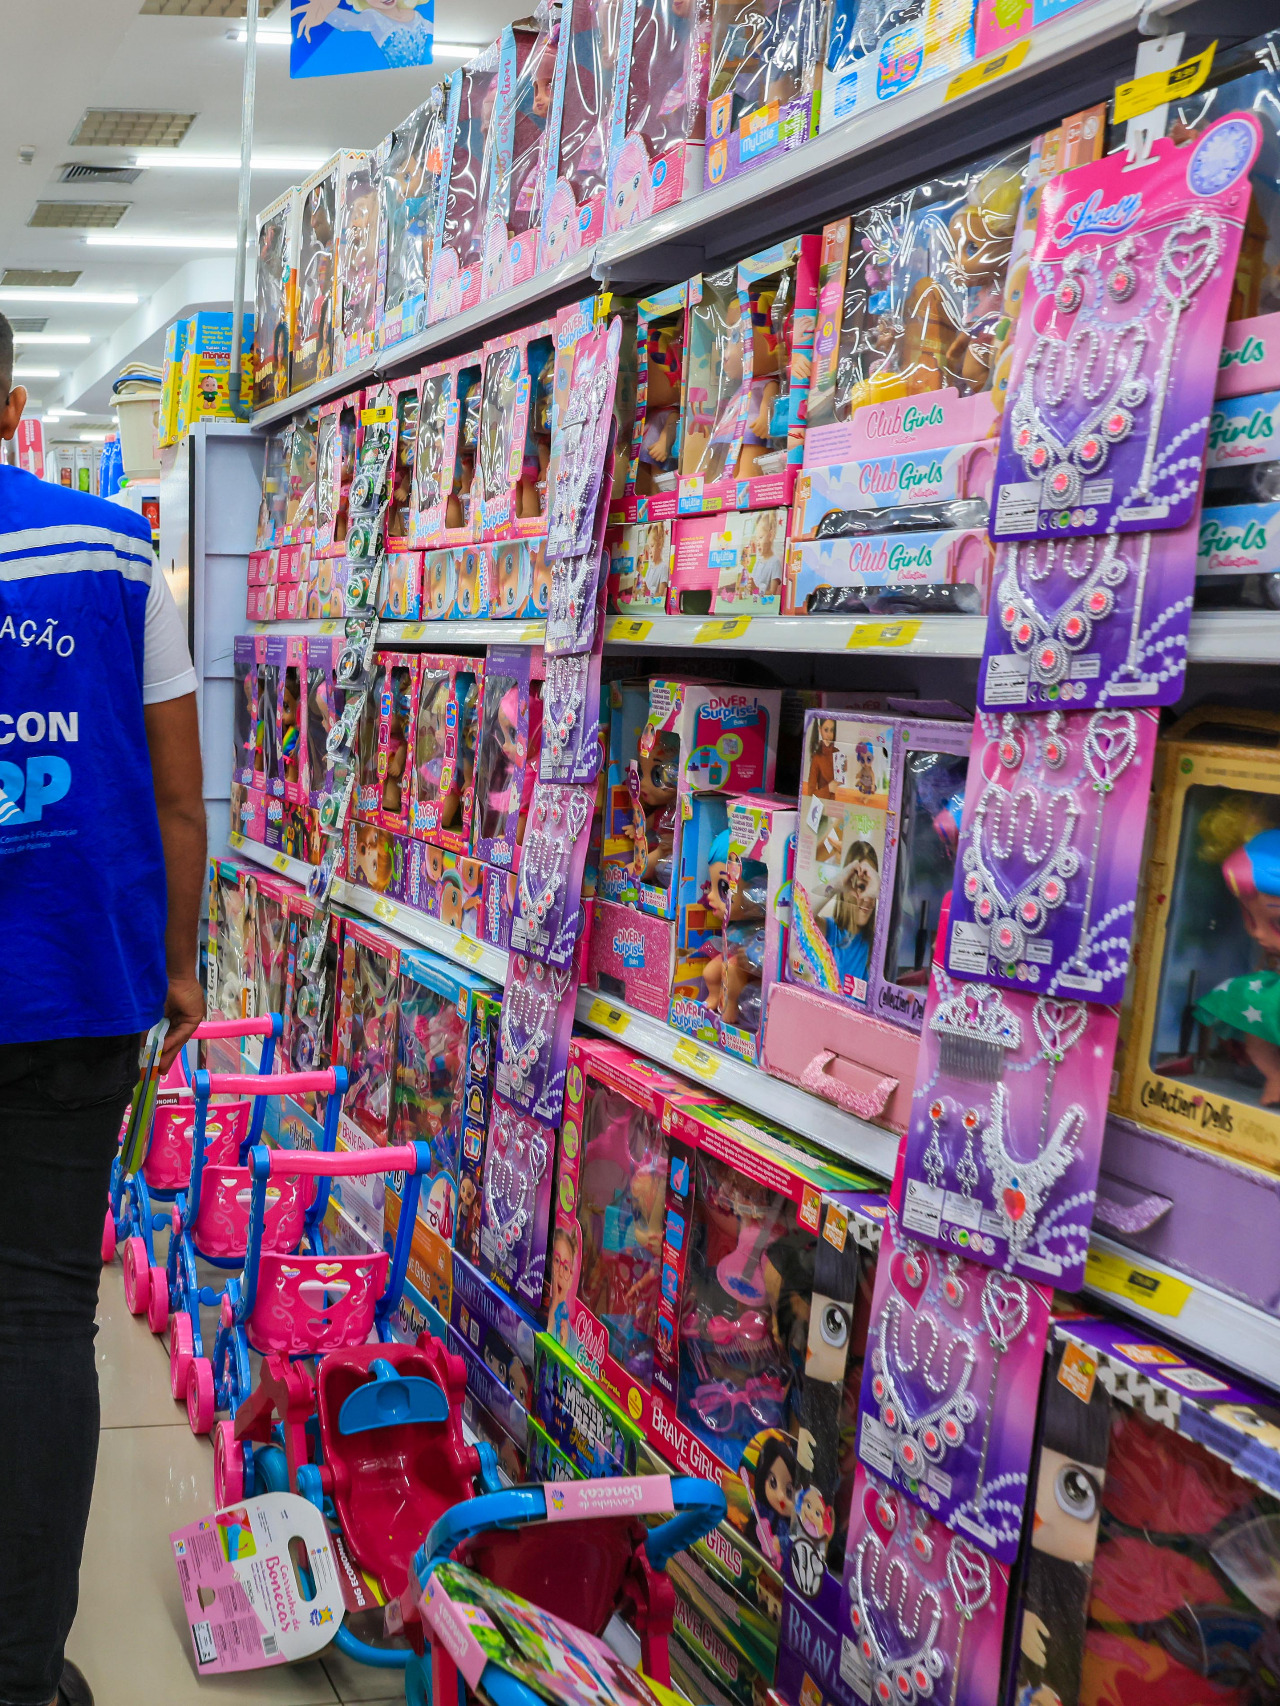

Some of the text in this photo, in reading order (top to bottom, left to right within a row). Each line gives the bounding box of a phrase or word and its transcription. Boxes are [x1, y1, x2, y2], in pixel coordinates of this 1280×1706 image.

[1052, 189, 1146, 249] Lovely
[202, 350, 231, 360] Mônica
[867, 403, 944, 439] Club Girls
[1209, 411, 1274, 449] Girls
[858, 457, 943, 495] Club Girls
[848, 540, 933, 572] Club Girls
[1197, 521, 1267, 557] Girls
[700, 697, 759, 721] Surprise!
[709, 695, 747, 709] DIVER
[604, 866, 623, 882] DIVER
[618, 928, 642, 944] DIVER
[671, 1007, 705, 1030] Surprise!
[674, 1000, 699, 1017] DIVER
[726, 1034, 755, 1050] SAQUINHOS
[1140, 1080, 1197, 1121] Collection
[1200, 1101, 1234, 1134] Dolls
[575, 1310, 606, 1365] Club
[652, 1405, 689, 1459] BRAVE
[578, 1484, 643, 1501] Bonecas
[336, 1537, 366, 1607] BIG ECONOMIA
[265, 1555, 290, 1634] Bonecas
[280, 1564, 301, 1632] Carrinho de
